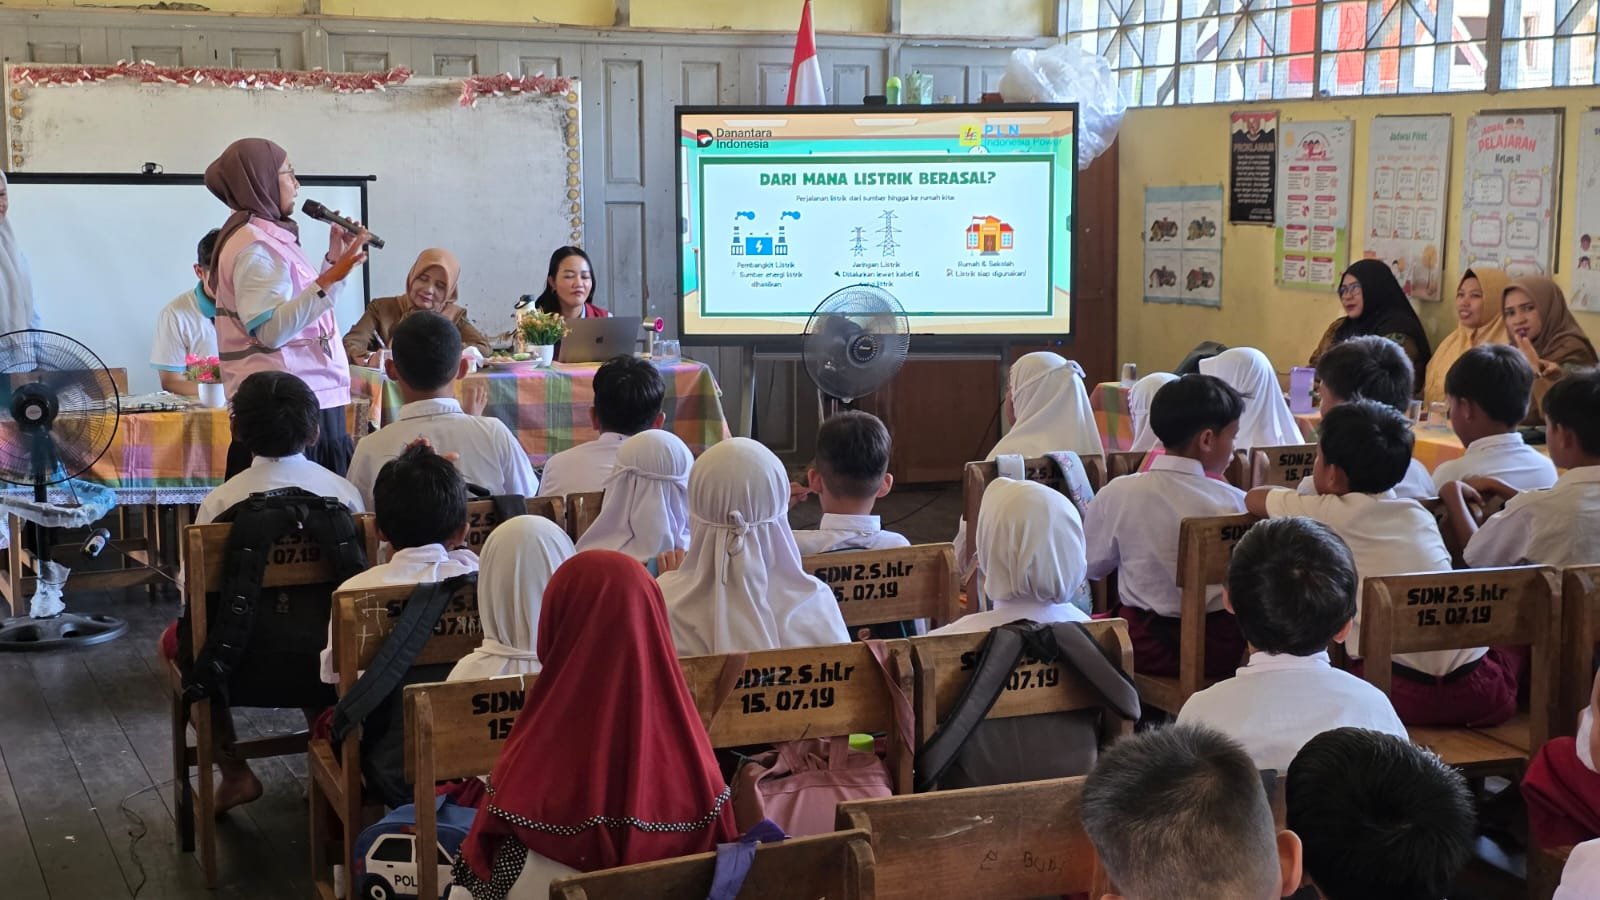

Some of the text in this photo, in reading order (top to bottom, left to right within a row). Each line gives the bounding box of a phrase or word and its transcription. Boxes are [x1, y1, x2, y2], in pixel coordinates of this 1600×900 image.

[716, 128, 772, 138] Danantara
[984, 124, 1020, 137] PLN
[716, 139, 769, 149] Indonesia
[1477, 134, 1537, 153] PELAJARAN
[760, 171, 996, 186] DARI MANA LISTRIK BERASAL?
[796, 194, 829, 203] Perjalanan
[888, 194, 909, 203] hingga
[472, 689, 525, 715] SDN
[394, 874, 418, 887] POL
